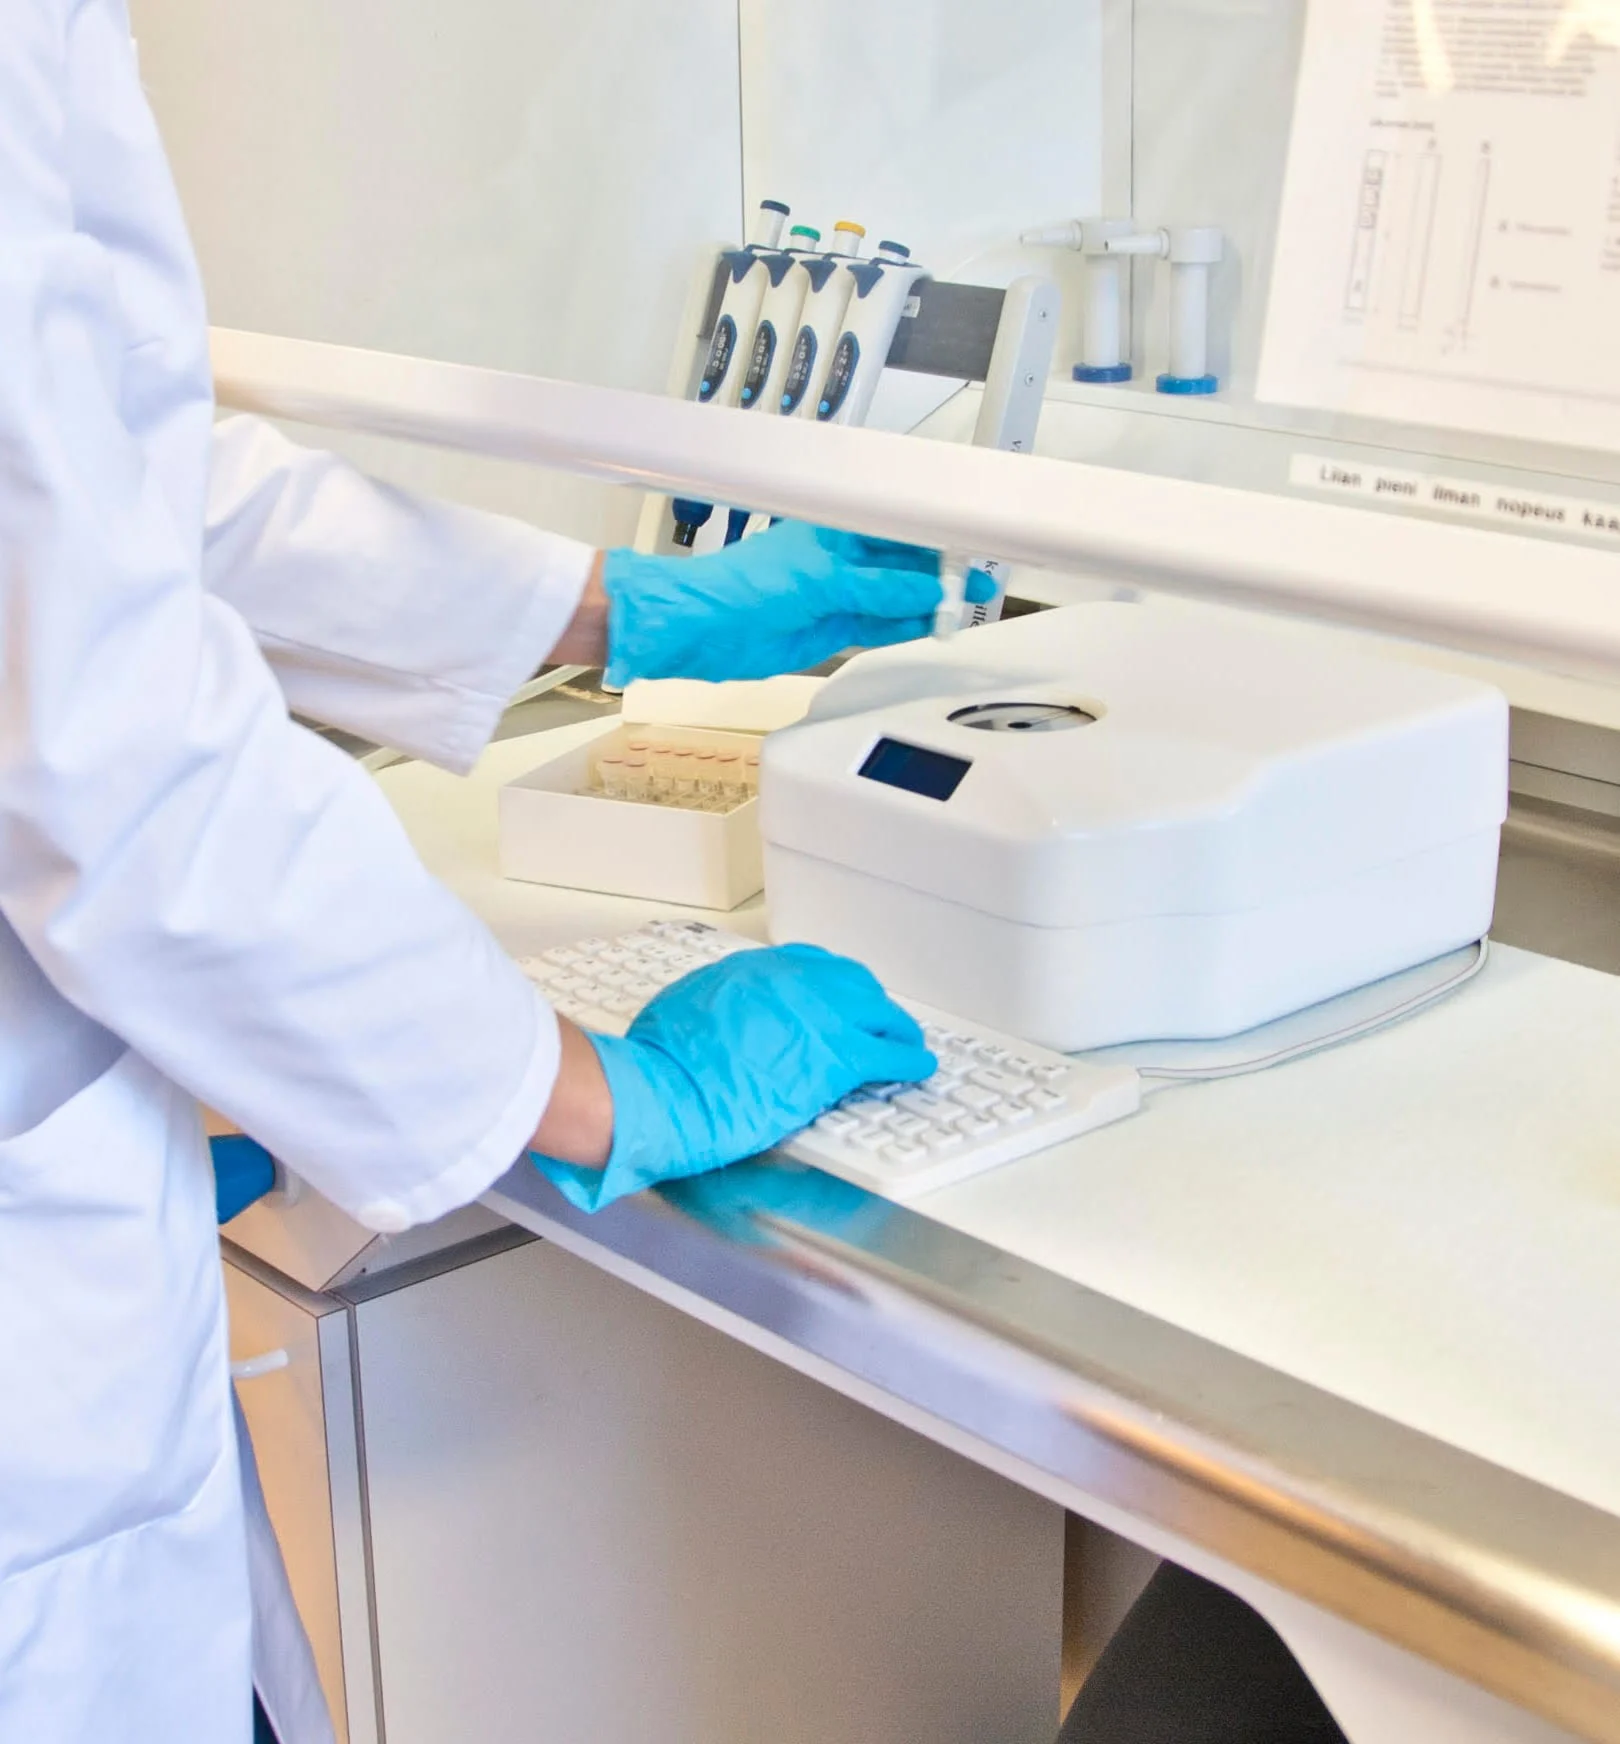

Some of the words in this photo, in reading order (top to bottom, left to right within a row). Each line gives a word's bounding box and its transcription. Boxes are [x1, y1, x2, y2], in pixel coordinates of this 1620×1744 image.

[1319, 463, 1362, 488] Liian
[1375, 476, 1418, 497] pieni
[1433, 484, 1481, 508] ilman
[1496, 497, 1564, 522] nopeus
